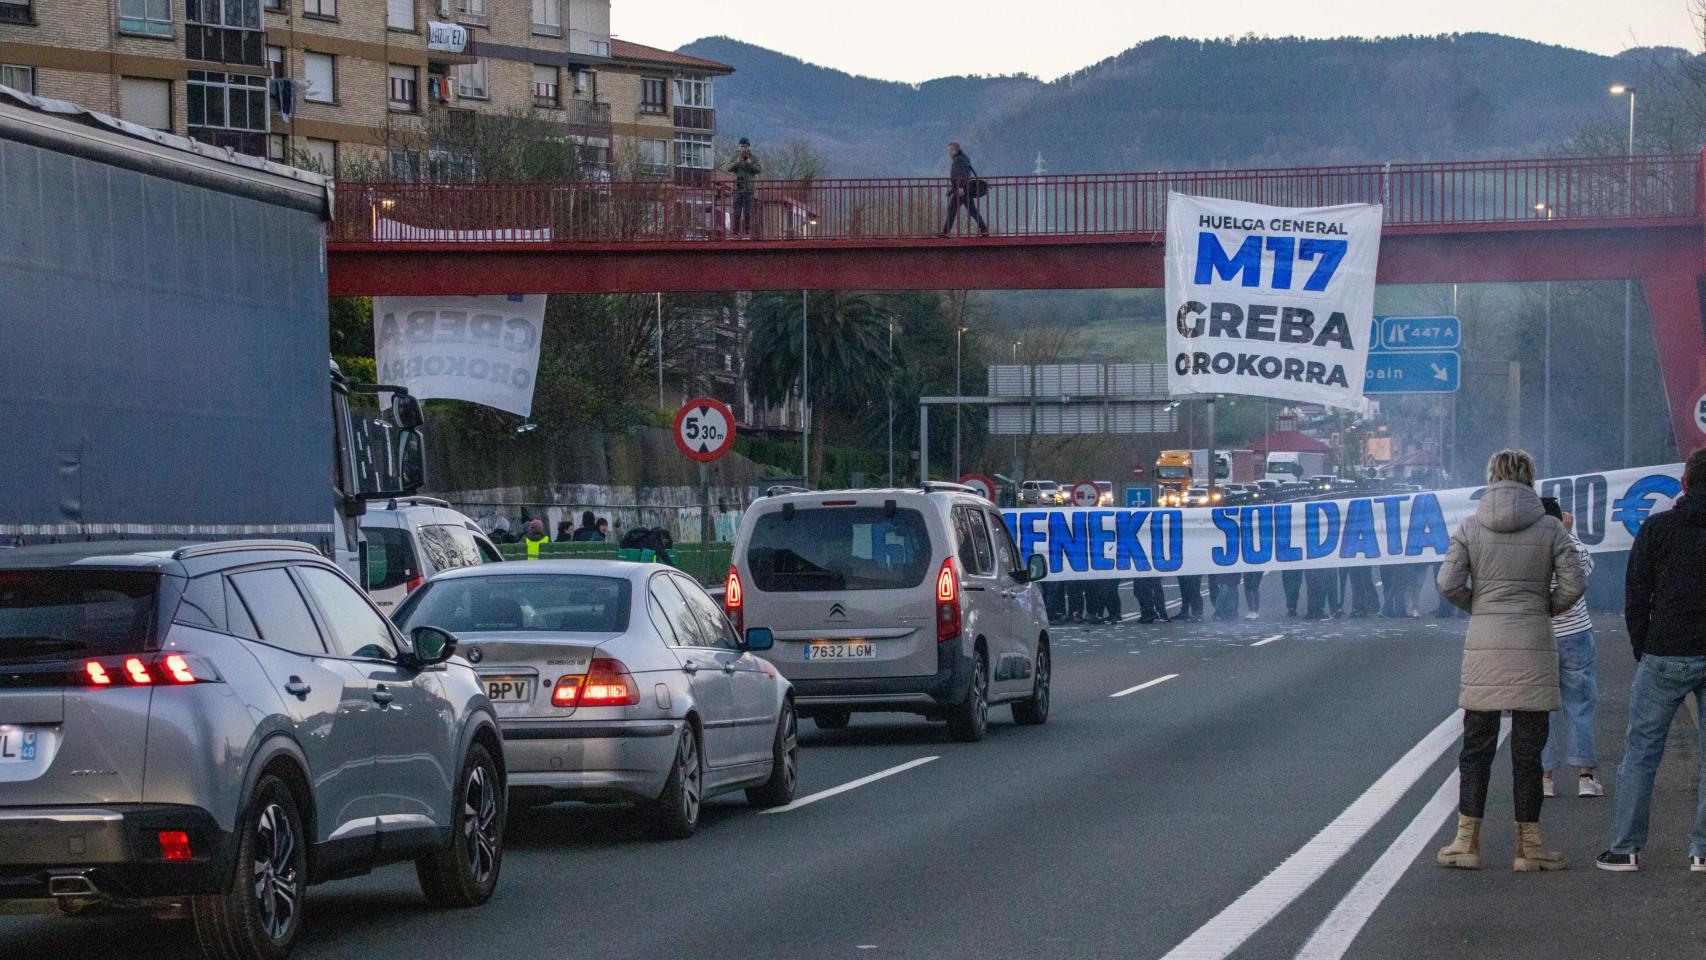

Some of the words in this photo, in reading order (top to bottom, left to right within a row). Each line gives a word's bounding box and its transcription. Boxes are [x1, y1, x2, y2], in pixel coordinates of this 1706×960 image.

[1199, 215, 1265, 231] HUELGA
[1269, 218, 1348, 235] GENERAL
[1194, 231, 1348, 292] M17
[1176, 300, 1354, 351] GREBA
[1411, 327, 1440, 338] 447
[1443, 327, 1454, 338] A
[1175, 351, 1349, 389] OROKORRA
[1212, 493, 1450, 566] SOLDATA
[812, 646, 844, 658] 7632
[848, 645, 872, 657] LGM
[488, 682, 525, 699] BPV
[0, 735, 16, 757] L
[22, 746, 35, 758] 40
